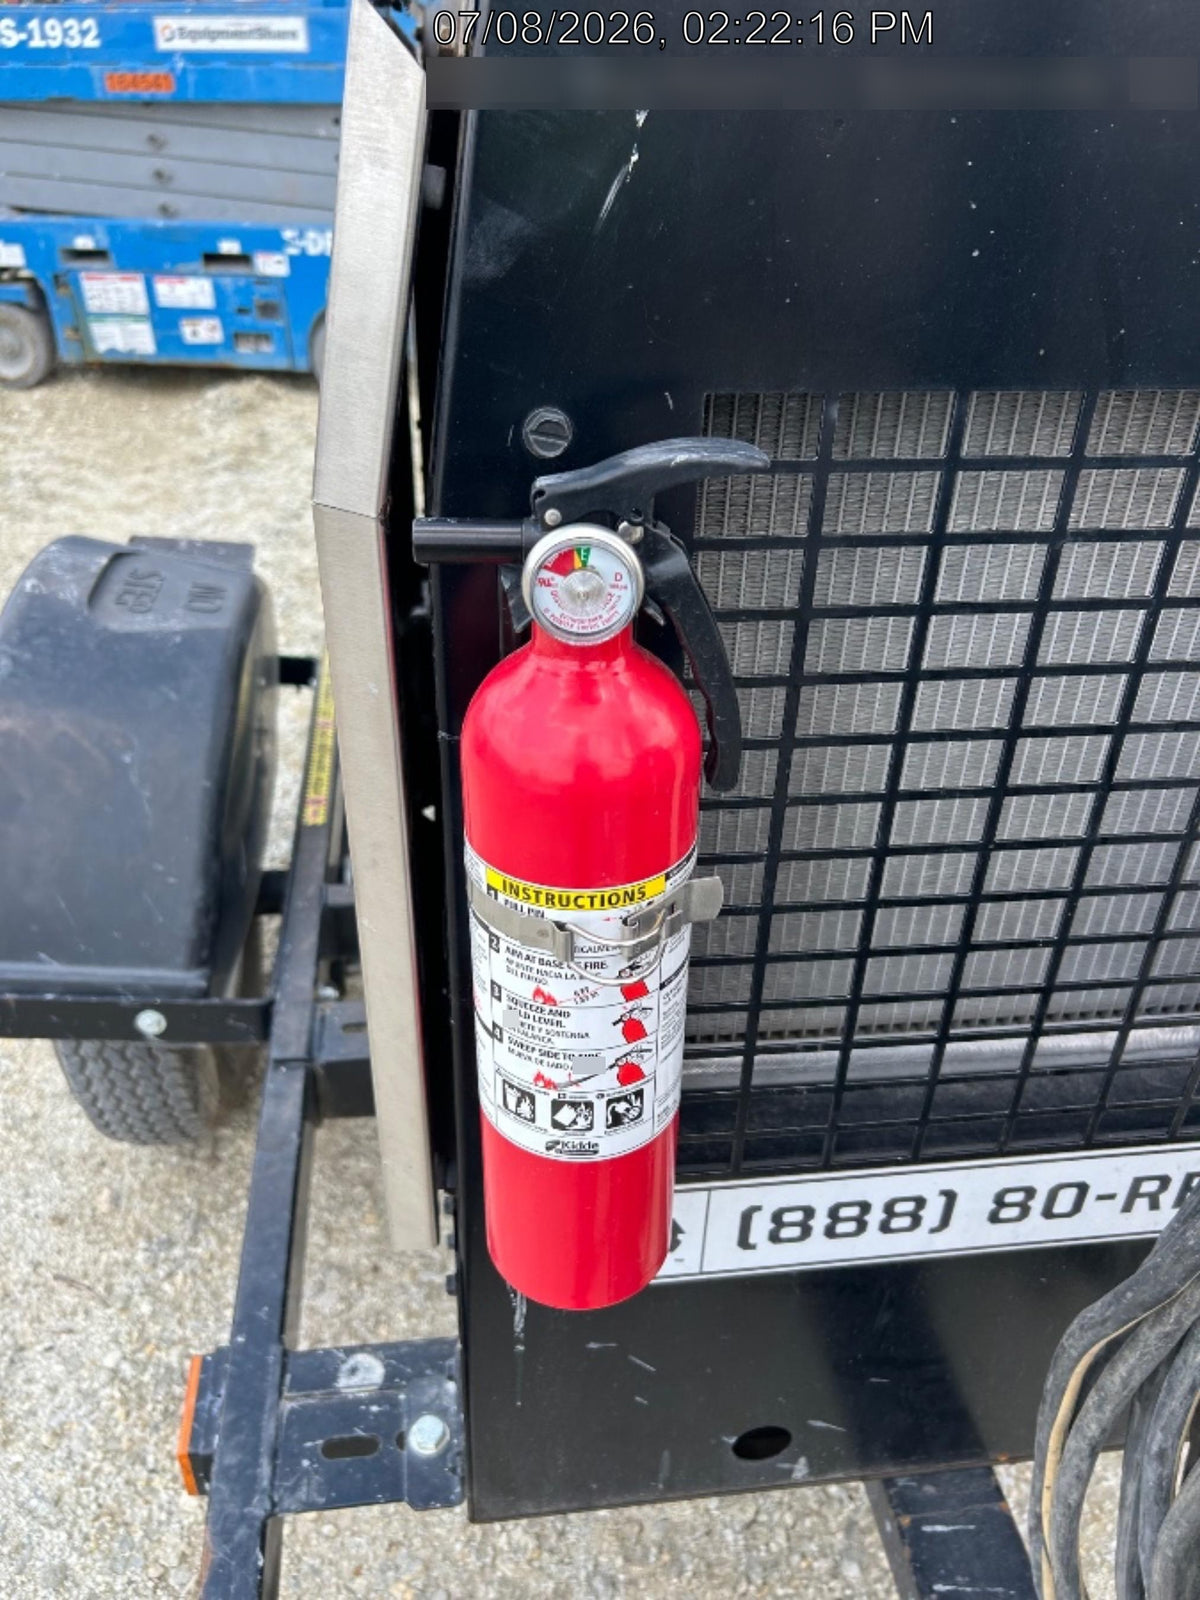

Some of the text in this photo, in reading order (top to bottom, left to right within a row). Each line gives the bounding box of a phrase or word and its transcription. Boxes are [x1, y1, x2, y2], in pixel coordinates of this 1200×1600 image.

[0, 17, 101, 48] S-1932
[502, 878, 648, 910] INSTRUCTIONS
[506, 993, 547, 1015] SQUEEZE
[547, 1008, 571, 1019] AND
[508, 1035, 537, 1054] SWEEP
[538, 1048, 561, 1060] SIDE
[560, 1139, 600, 1150] Kidde
[737, 1189, 958, 1251] (888)
